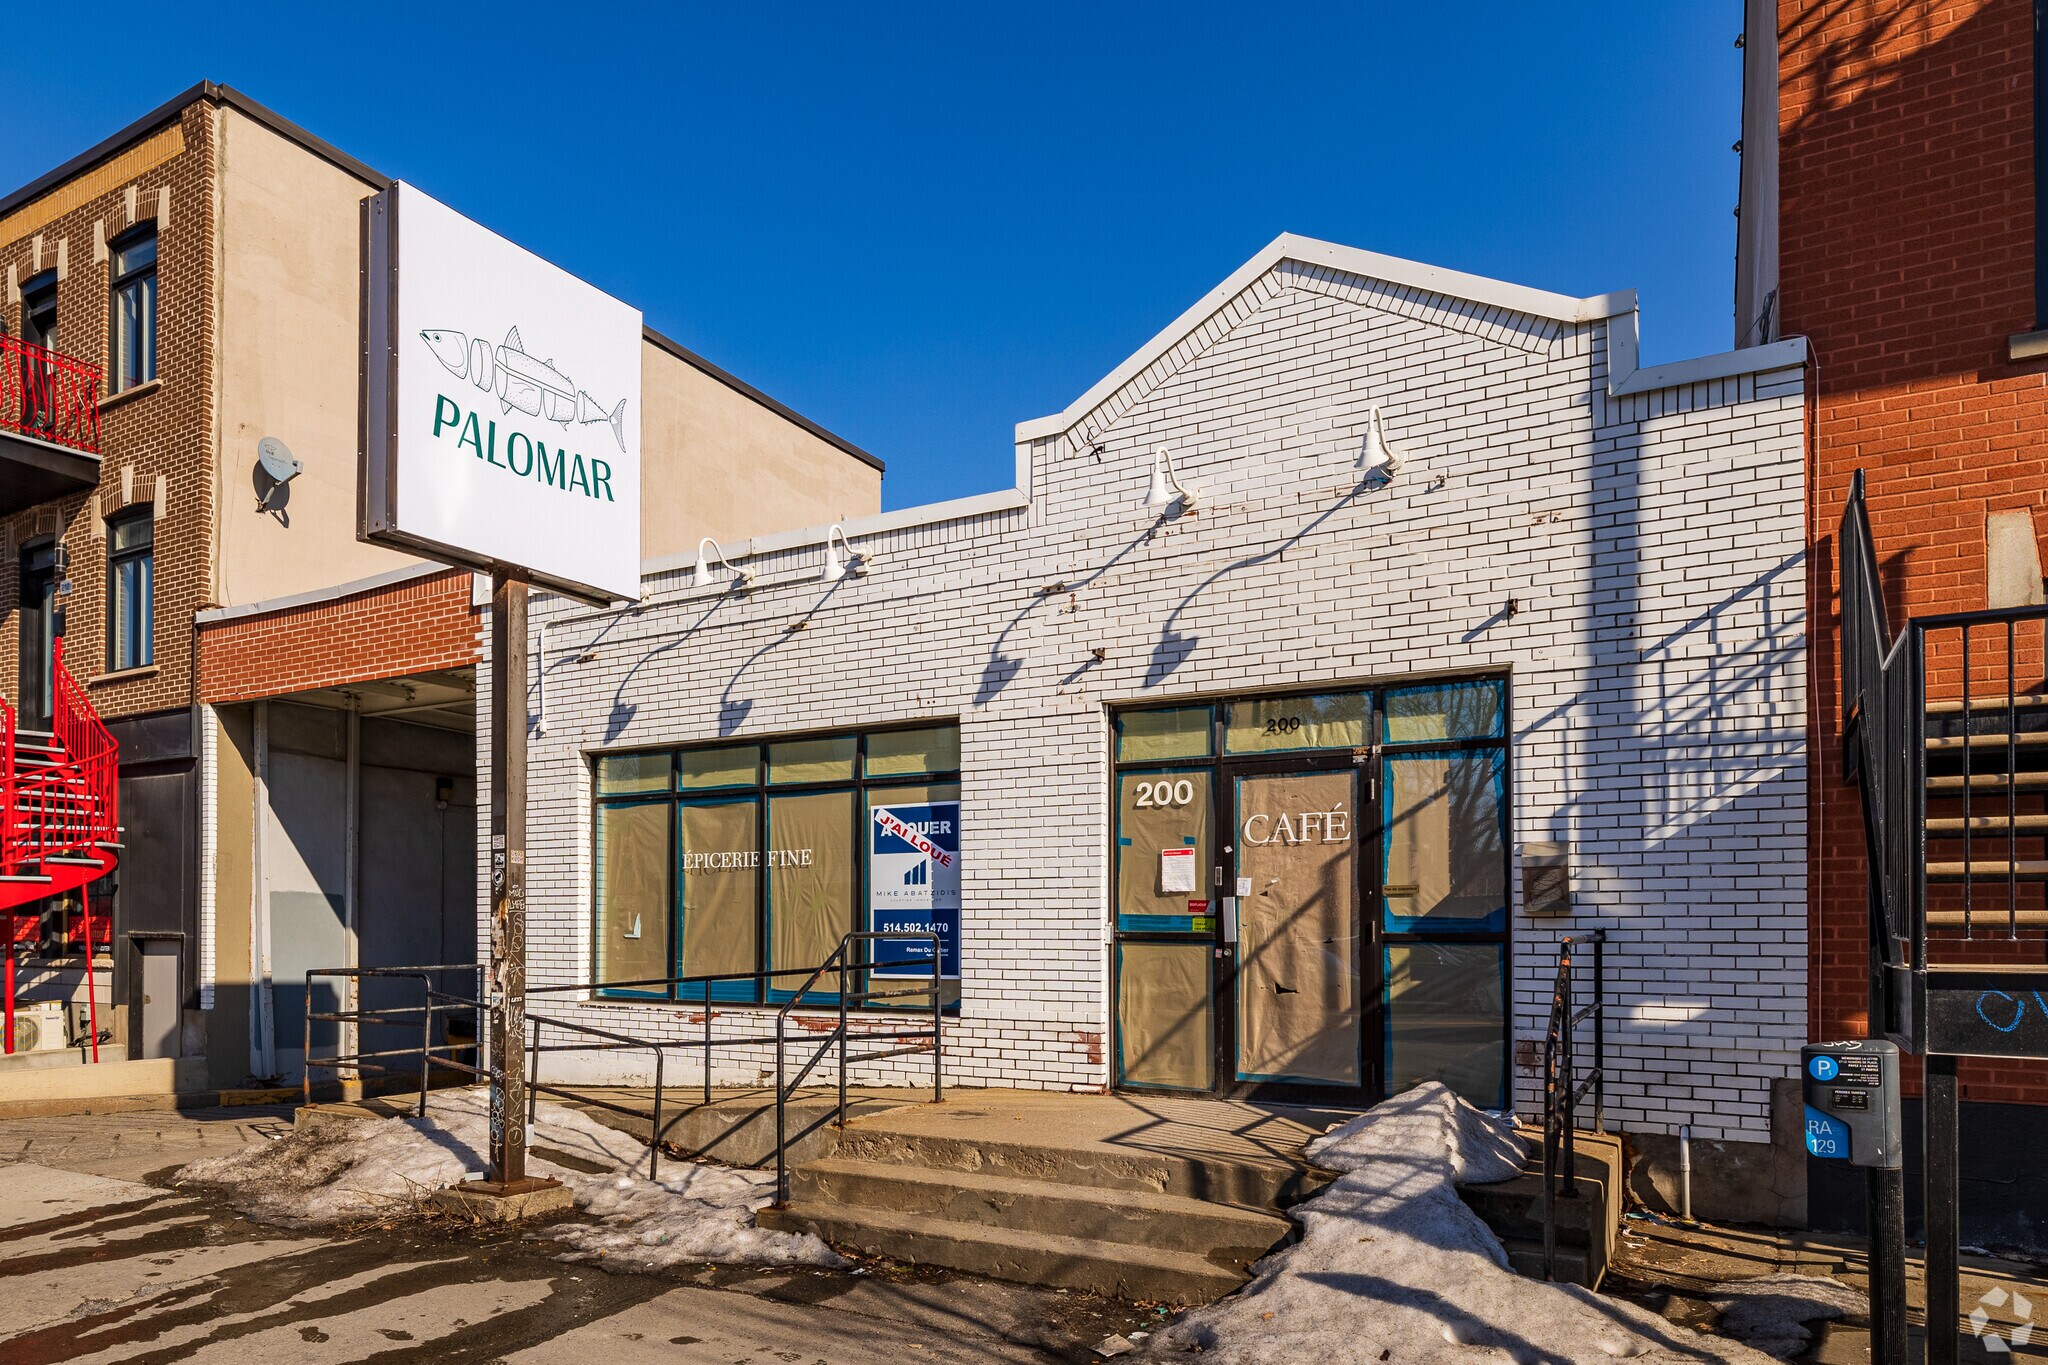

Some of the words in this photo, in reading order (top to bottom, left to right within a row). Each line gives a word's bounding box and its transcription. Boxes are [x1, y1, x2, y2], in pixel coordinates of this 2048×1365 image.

[433, 393, 615, 502] PALOMAR
[1266, 716, 1300, 731] 200
[1136, 779, 1194, 806] 200
[1244, 802, 1351, 844] CAFÉ
[880, 816, 908, 838] J'AI
[911, 834, 952, 868] LOUÉ
[682, 849, 760, 869] ÉPICERIE
[767, 848, 812, 867] FINE
[904, 889, 957, 897] ABATZIDIS
[883, 922, 949, 933] 514.502.1470
[1808, 1120, 1832, 1134] RA
[1811, 1138, 1836, 1153] 129
